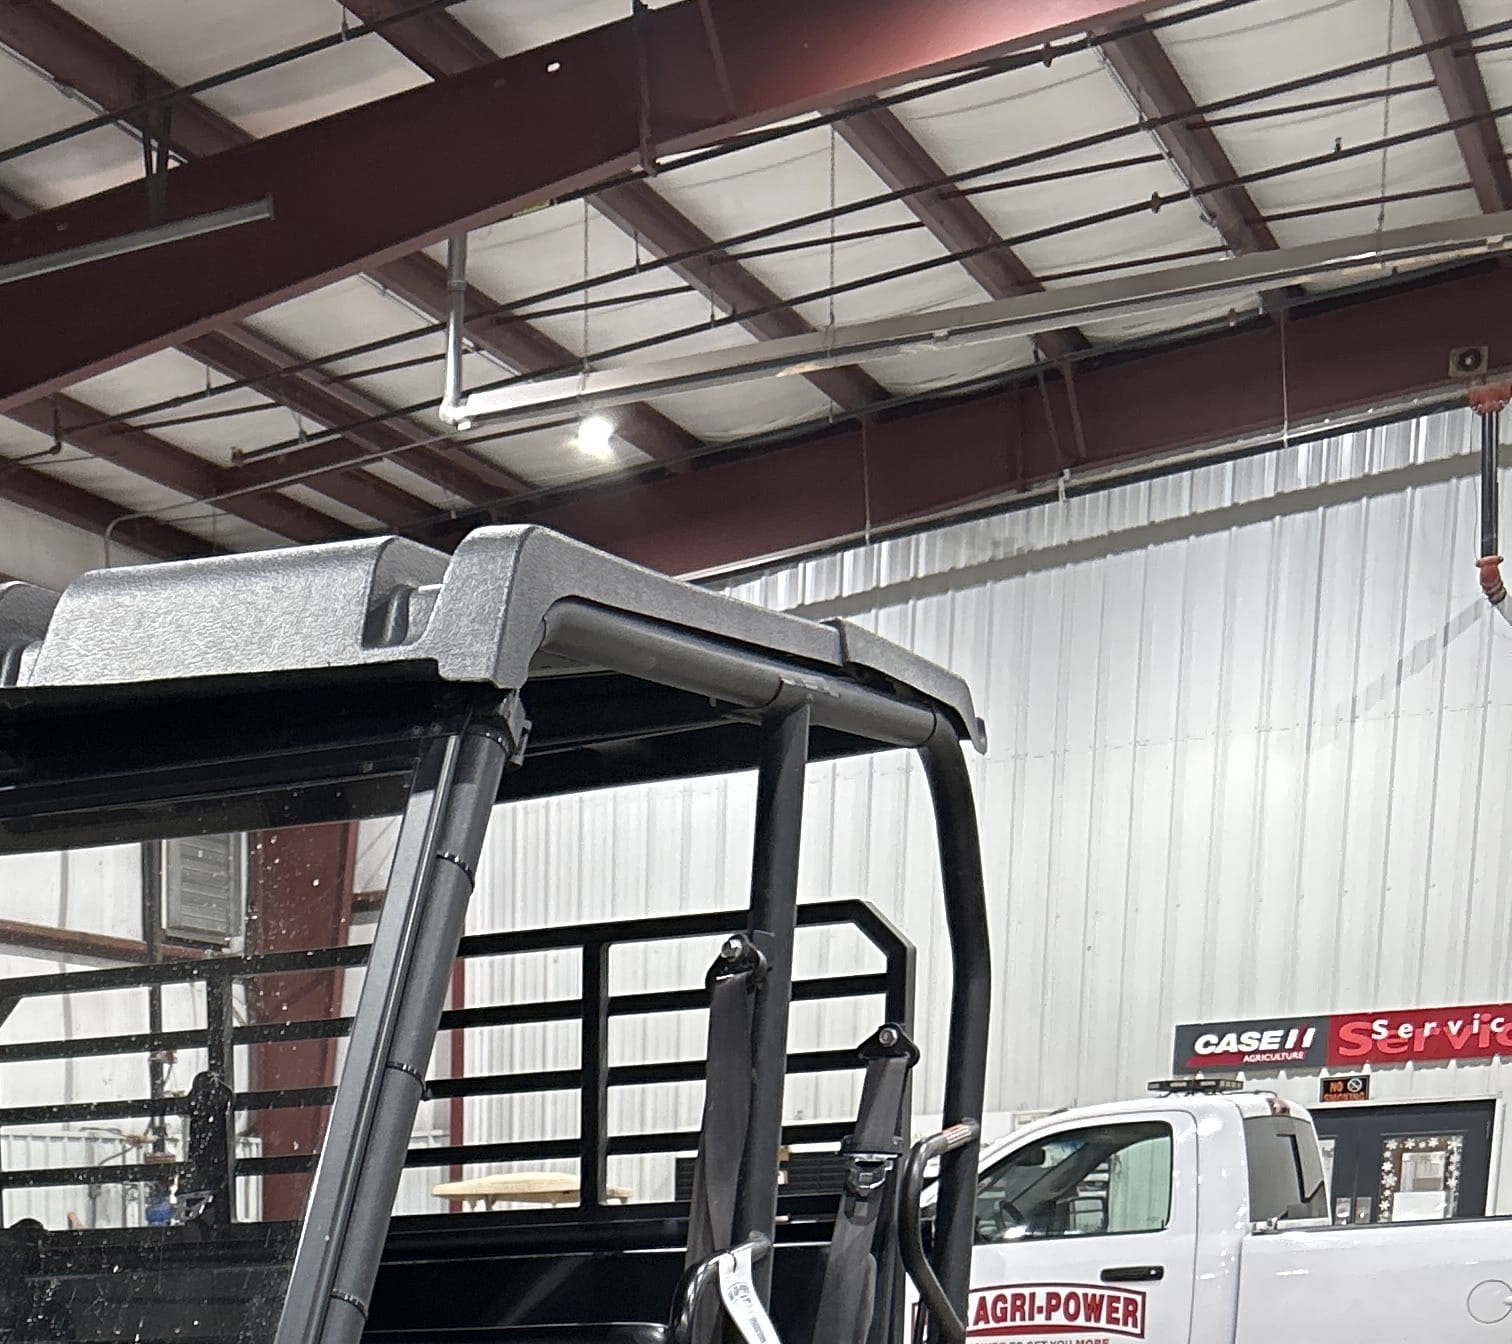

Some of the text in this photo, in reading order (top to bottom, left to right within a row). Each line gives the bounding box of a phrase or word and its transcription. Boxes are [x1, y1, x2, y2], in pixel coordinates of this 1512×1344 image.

[1194, 1029, 1284, 1055] CASE
[1242, 1051, 1305, 1063] AGRICULTURE
[1330, 1081, 1344, 1092] NO
[973, 1291, 1139, 1329] AGRI-POWER
